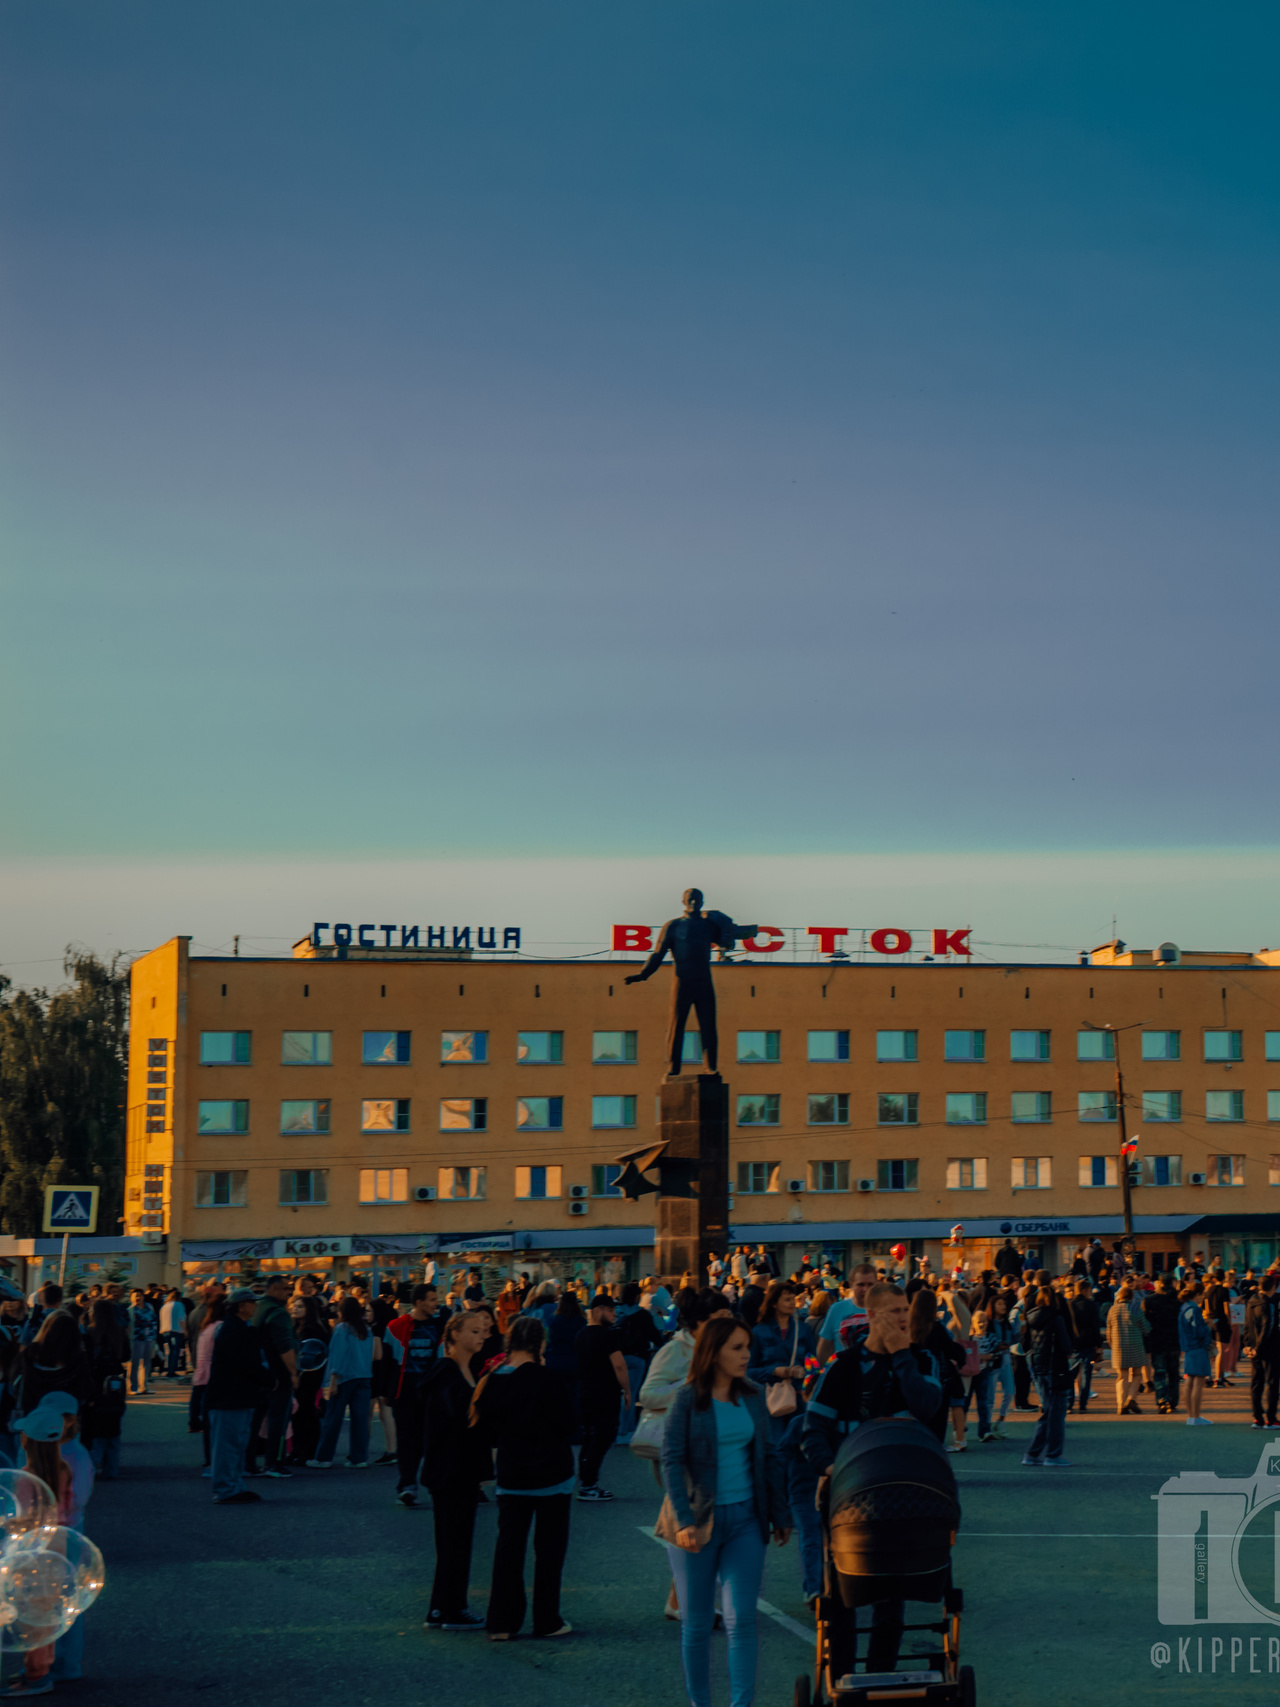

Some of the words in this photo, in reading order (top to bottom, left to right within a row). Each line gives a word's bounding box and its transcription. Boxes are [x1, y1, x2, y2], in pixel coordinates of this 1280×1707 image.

[313, 922, 521, 949] ГОСТИНИЦА
[610, 924, 973, 955] ВСТОК
[147, 1039, 166, 1133] VOSTOK
[145, 1164, 162, 1242] HOTEL
[1015, 1222, 1070, 1233] СБЕРБАНК
[284, 1241, 341, 1254] Кафе
